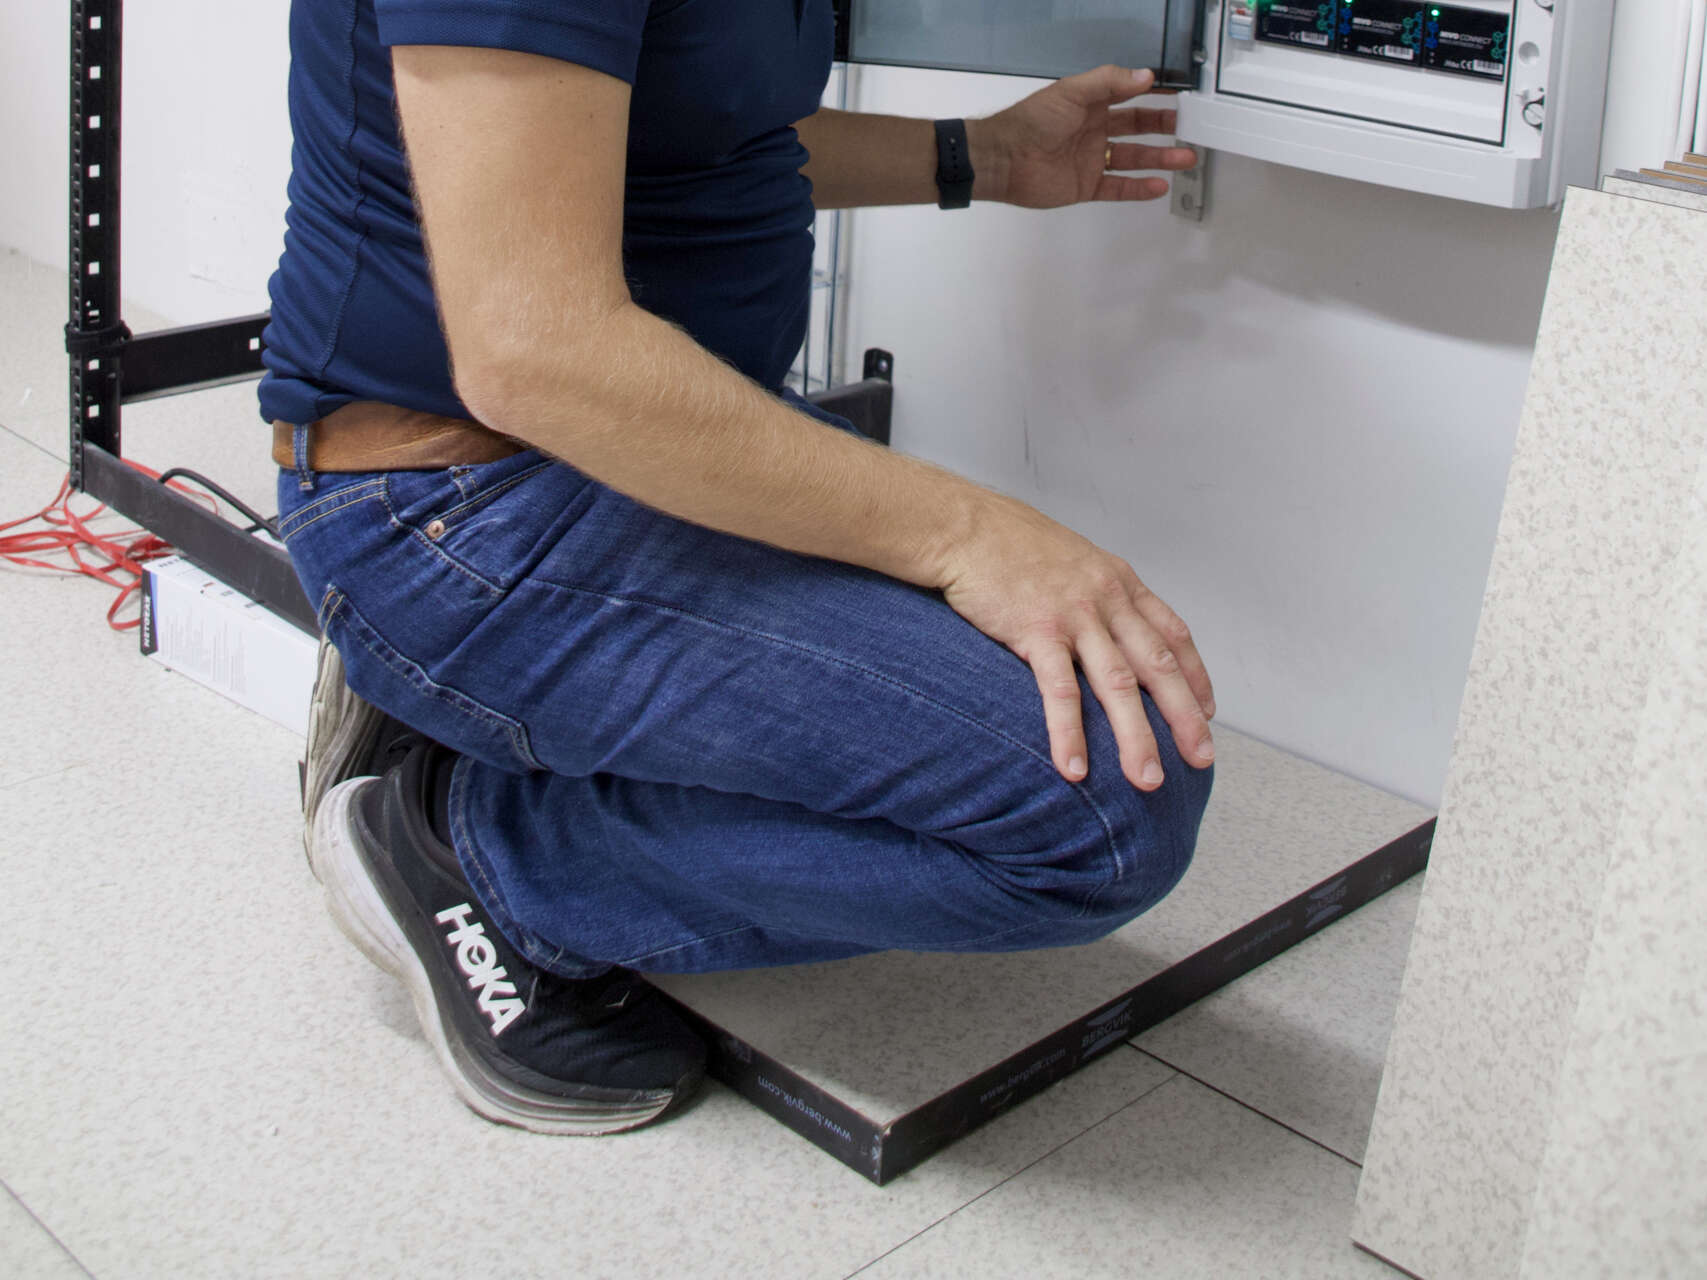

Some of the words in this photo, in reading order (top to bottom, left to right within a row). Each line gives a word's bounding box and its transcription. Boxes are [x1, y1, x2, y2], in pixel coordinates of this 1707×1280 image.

[143, 594, 151, 648] NETGEAR
[434, 903, 527, 1037] HOKA
[1081, 1010, 1133, 1048] BERGVIK
[757, 1075, 852, 1142] www.bergvik.com
